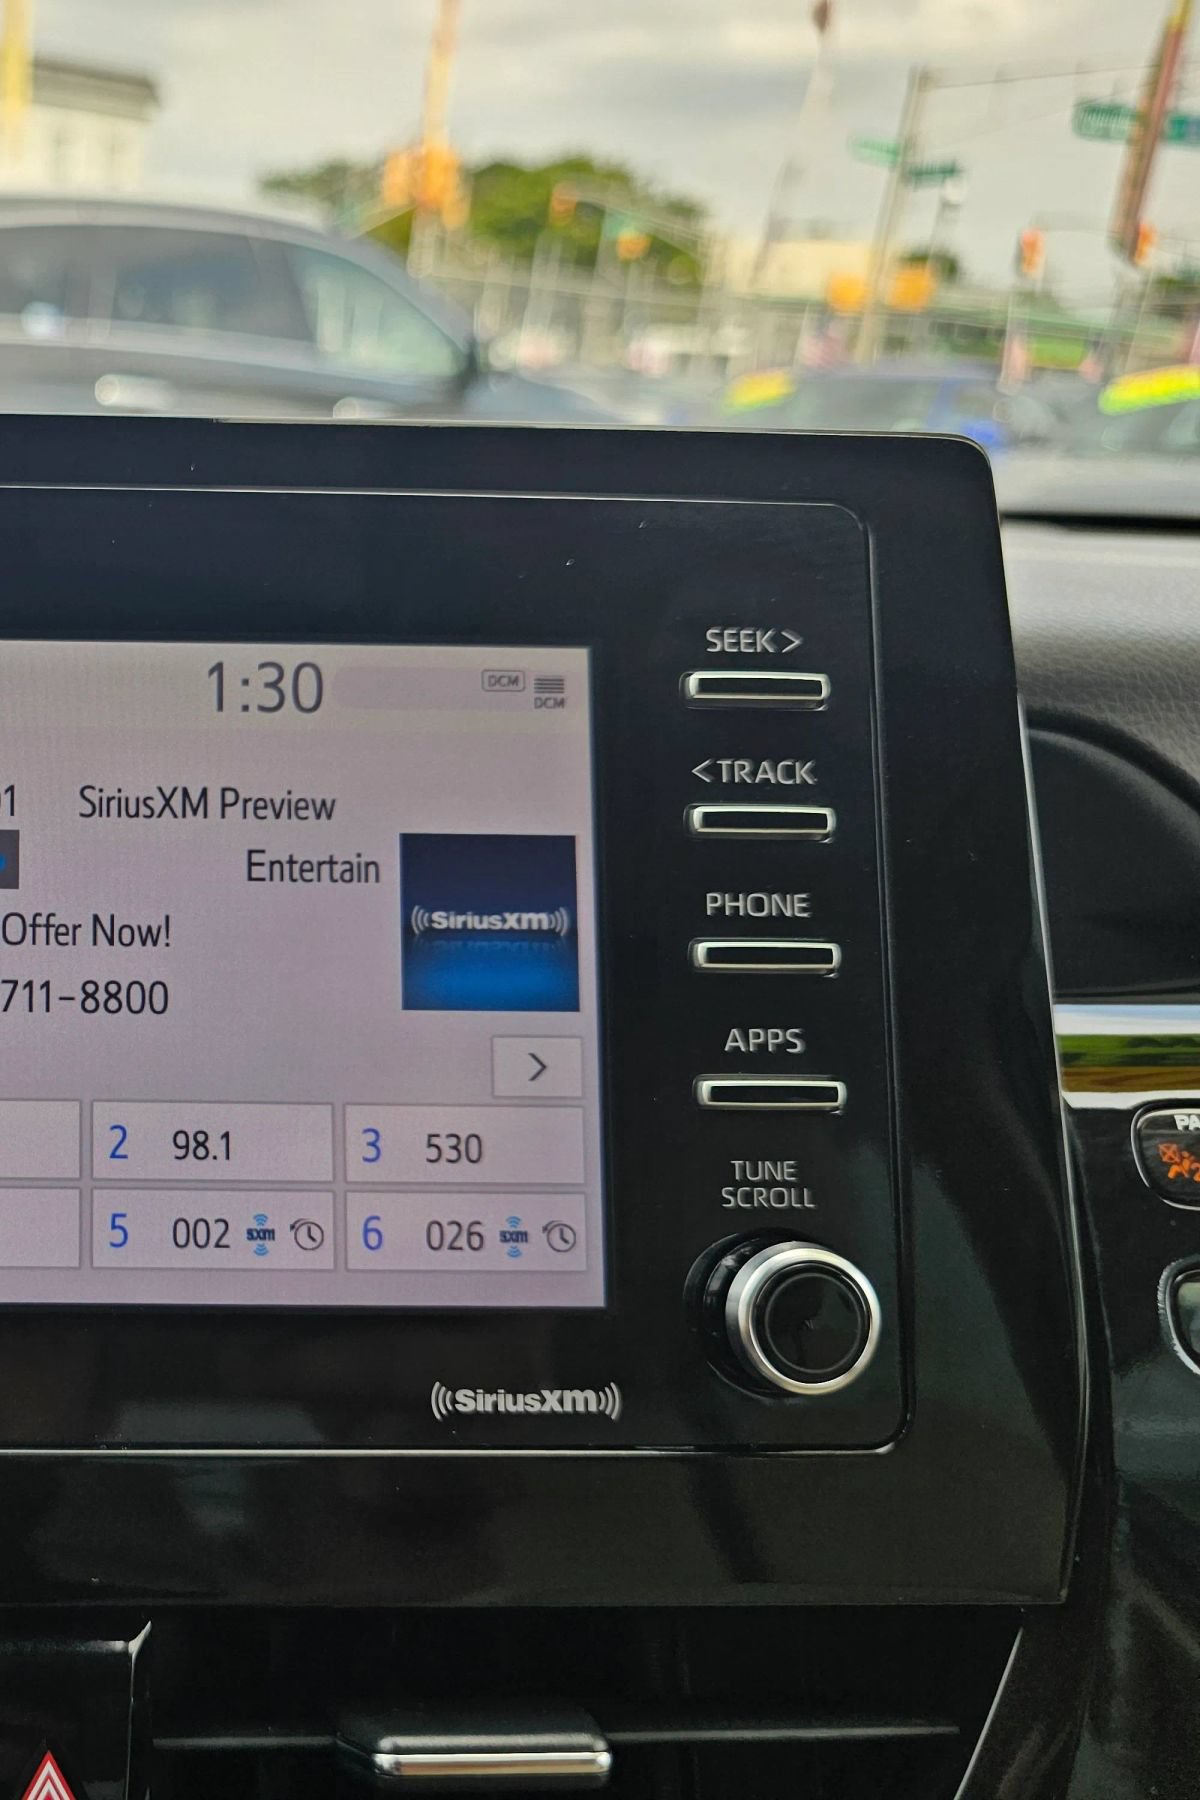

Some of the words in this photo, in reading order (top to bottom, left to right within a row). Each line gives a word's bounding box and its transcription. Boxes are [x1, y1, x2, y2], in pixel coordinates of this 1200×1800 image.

[207, 661, 325, 714] 1:30
[487, 674, 520, 688] DCM
[533, 696, 566, 709] DCM
[78, 785, 209, 821] SiriusXM
[219, 787, 337, 821] Preview
[246, 849, 381, 885] Entertain
[705, 892, 812, 919] PHONE
[0, 912, 83, 948] Offer
[91, 914, 172, 948] Now!
[723, 1027, 807, 1054] APPS
[108, 1124, 129, 1160] 2
[171, 1130, 233, 1162] 98.1
[361, 1128, 382, 1163] 3
[424, 1132, 484, 1165] 530
[730, 1159, 799, 1182] TUNE
[720, 1186, 817, 1210] SCROLL
[108, 1213, 130, 1249] 5
[171, 1217, 232, 1250] 002
[361, 1216, 384, 1252] 6
[424, 1220, 485, 1253] 026
